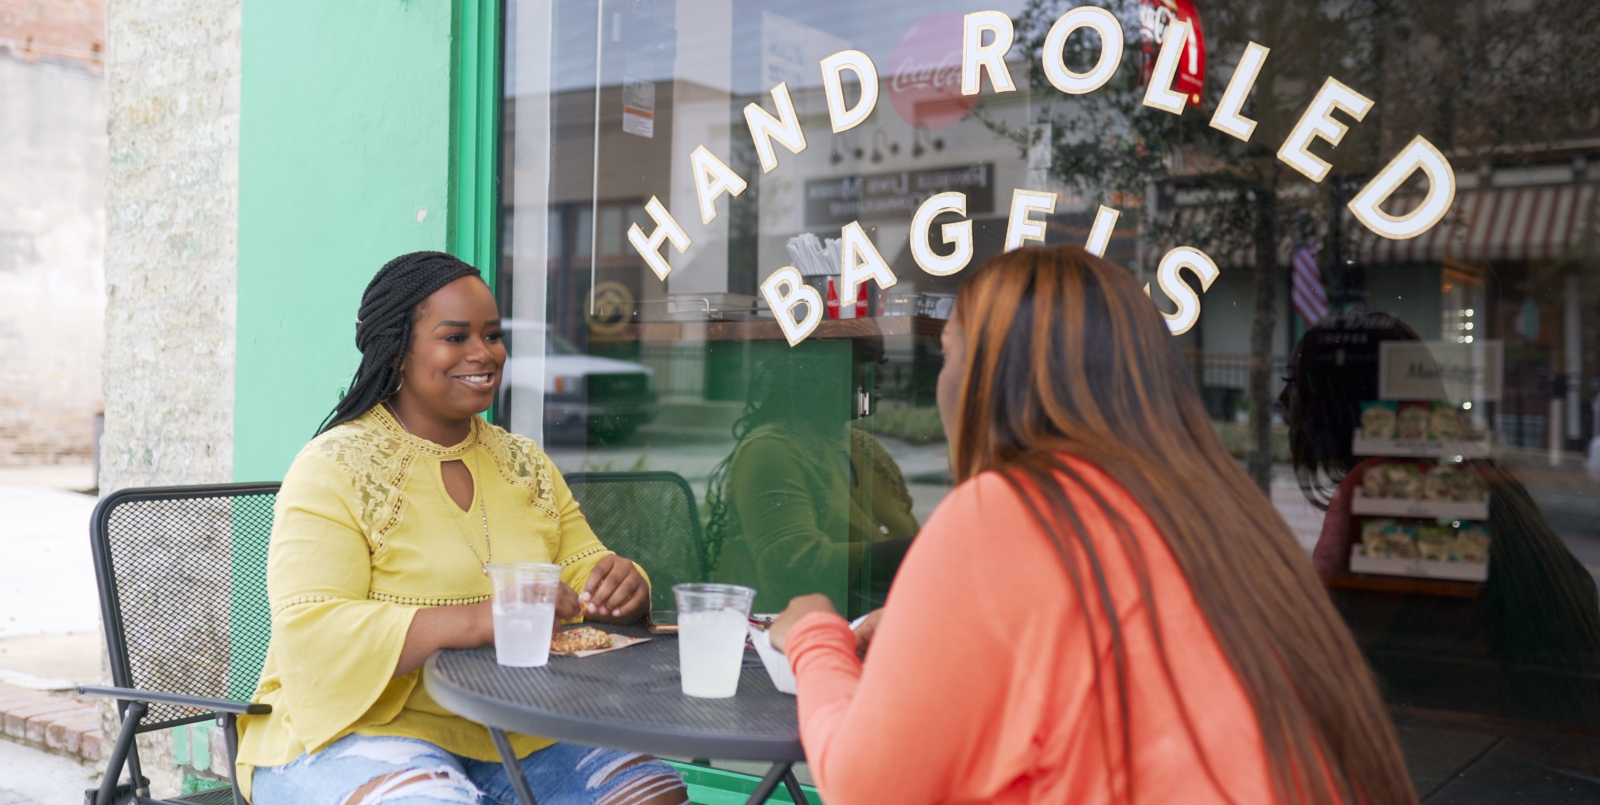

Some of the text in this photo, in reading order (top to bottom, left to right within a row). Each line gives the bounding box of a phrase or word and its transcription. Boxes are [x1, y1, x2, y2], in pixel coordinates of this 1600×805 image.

[627, 6, 1456, 281] HAND ROLLED
[892, 50, 963, 92] Coca-Co
